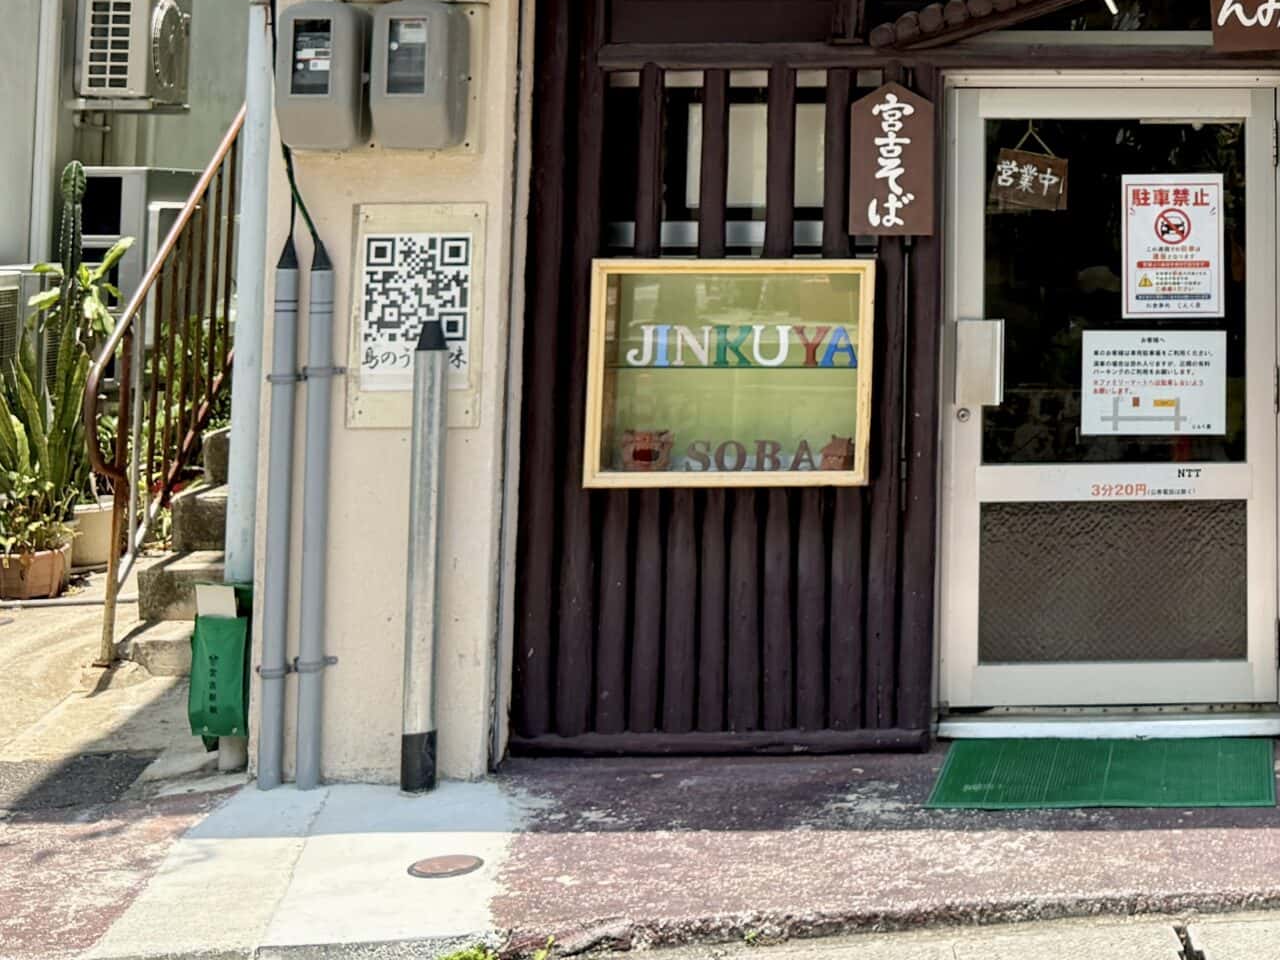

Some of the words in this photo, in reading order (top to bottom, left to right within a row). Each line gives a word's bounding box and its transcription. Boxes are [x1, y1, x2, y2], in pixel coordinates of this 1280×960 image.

[867, 92, 916, 228] 宮古そば
[996, 159, 1060, 197] 営業中
[1131, 187, 1211, 207] 駐車禁止
[626, 324, 859, 368] JINKUYA
[684, 438, 819, 473] SOBA
[1177, 468, 1202, 478] NTT
